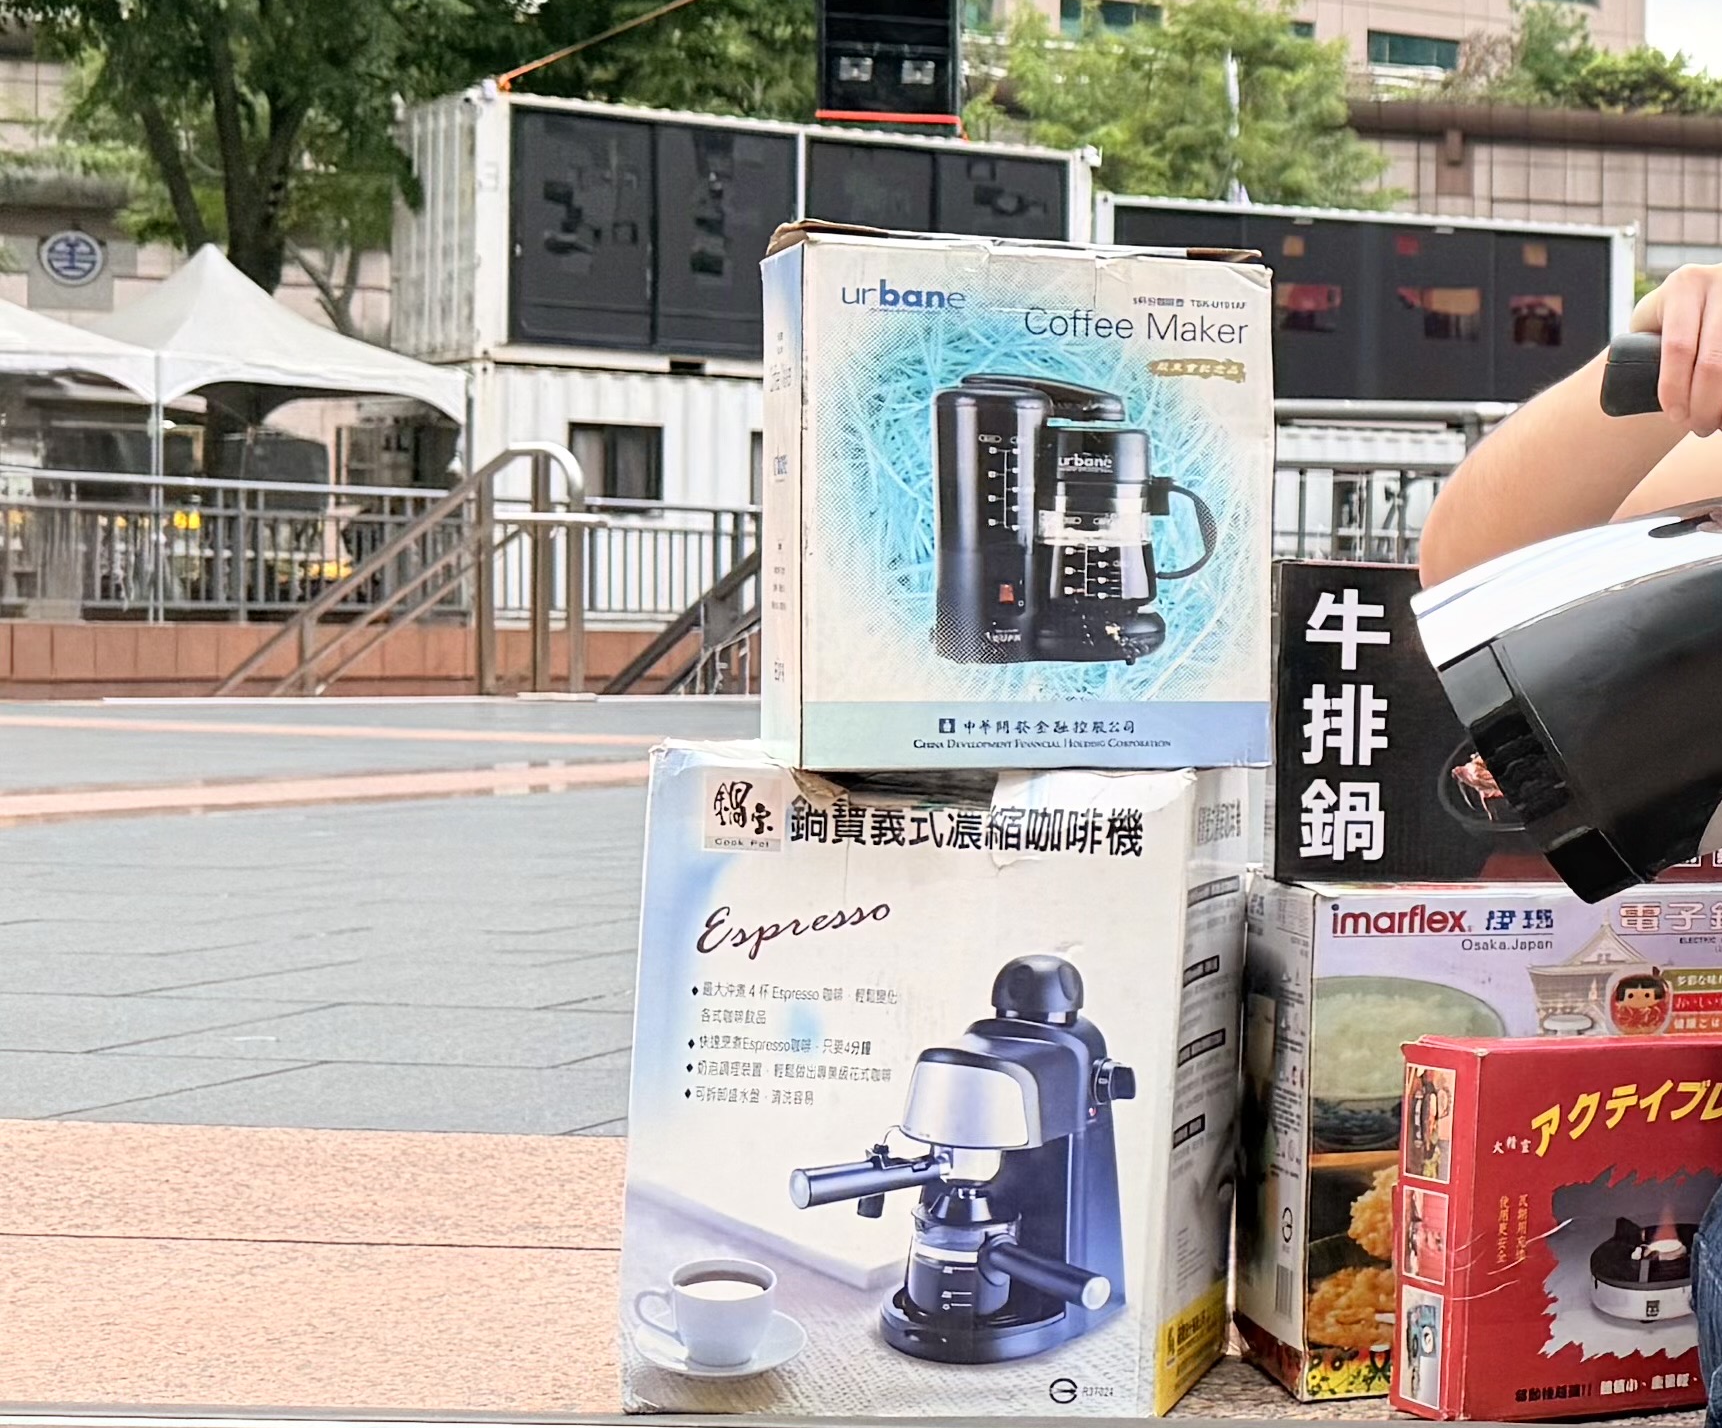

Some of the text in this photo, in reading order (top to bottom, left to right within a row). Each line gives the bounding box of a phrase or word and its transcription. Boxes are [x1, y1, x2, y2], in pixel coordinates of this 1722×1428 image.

[842, 278, 967, 310] urbane
[1025, 306, 1249, 345] Coffee Maker
[1300, 588, 1392, 862] 牛排鍋
[695, 901, 891, 961] Espresso
[1331, 904, 1468, 935] imarflex
[772, 986, 819, 1002] Espresso
